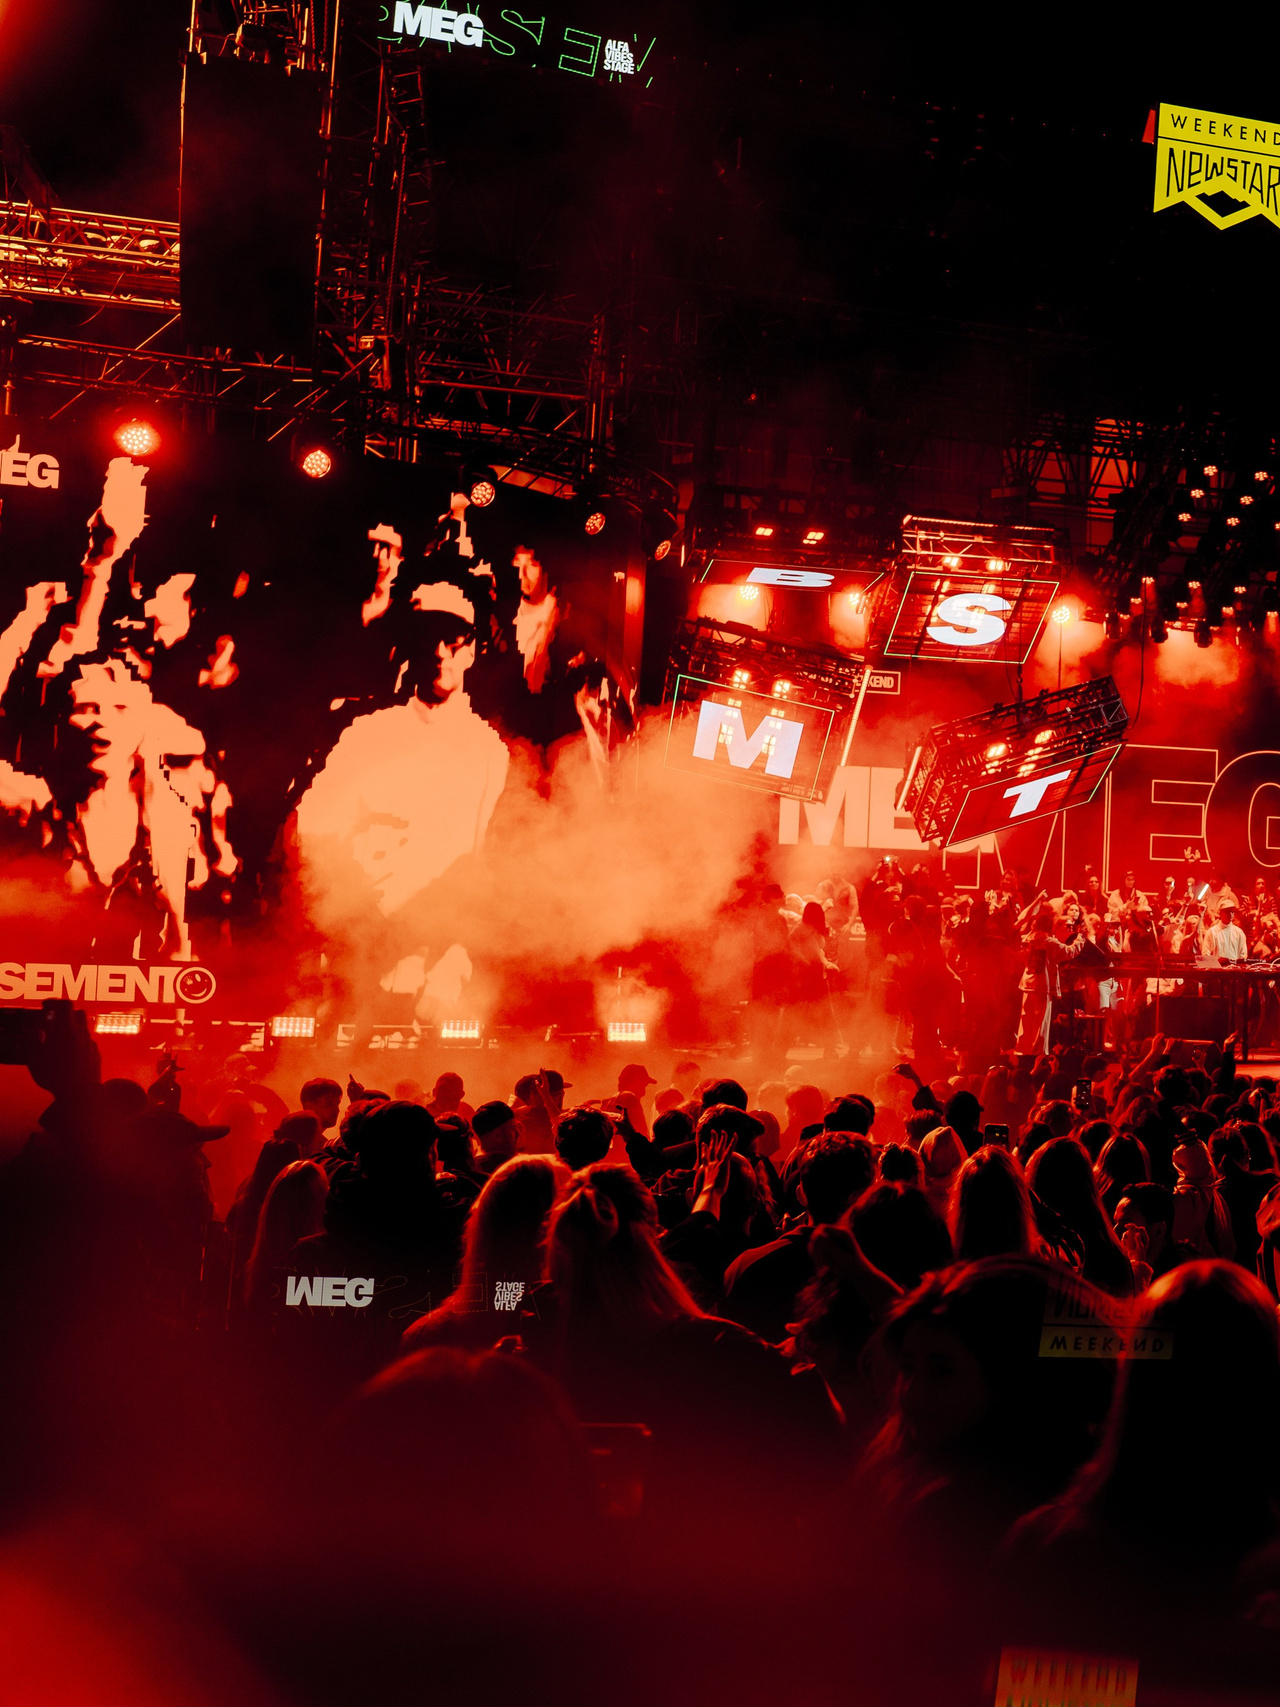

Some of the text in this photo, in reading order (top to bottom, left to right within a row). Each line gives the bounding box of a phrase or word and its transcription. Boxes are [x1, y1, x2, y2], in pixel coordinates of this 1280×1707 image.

[393, 1, 484, 47] MEG
[605, 39, 629, 53] ALFA
[603, 59, 635, 75] STAGE
[605, 49, 634, 64] VIBES
[0, 451, 59, 490] EG
[926, 593, 1012, 646] S
[693, 700, 804, 779] M
[778, 766, 996, 853] ME
[1003, 769, 1072, 818] T
